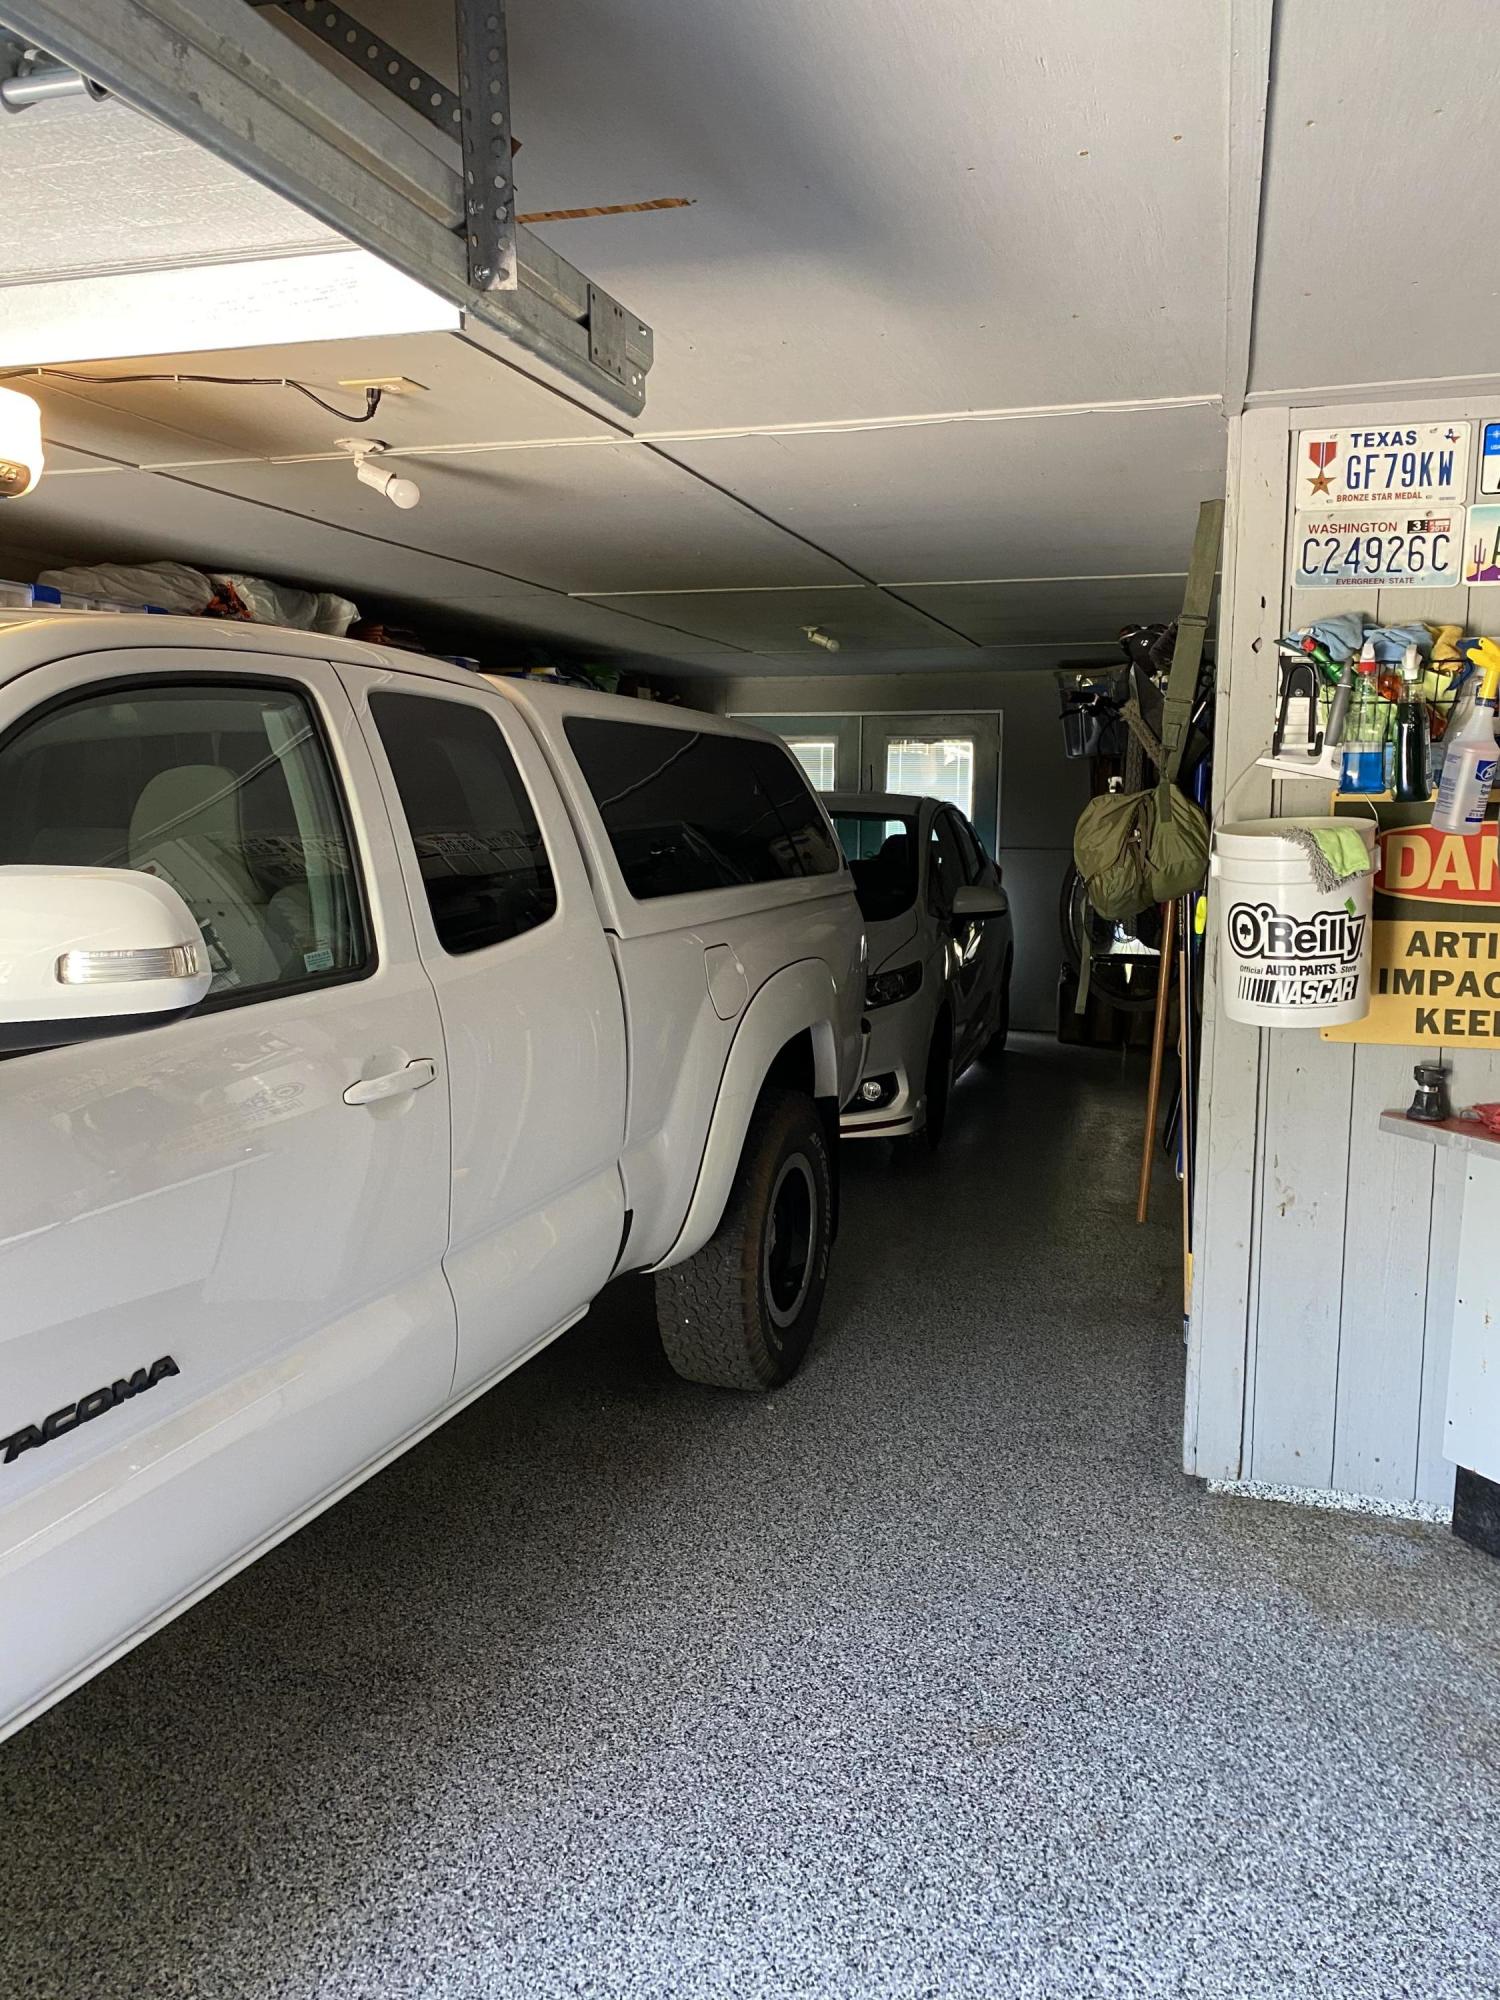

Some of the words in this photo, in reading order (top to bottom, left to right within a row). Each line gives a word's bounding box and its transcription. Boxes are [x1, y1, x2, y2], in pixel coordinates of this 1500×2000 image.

[1351, 430, 1417, 448] TEXAS
[1346, 450, 1454, 489] GF79KW
[1336, 494, 1369, 502] BRONZE
[1371, 492, 1393, 501] STAR
[1394, 491, 1422, 500] MEDAL
[1308, 521, 1398, 534] WASHINGTON
[1412, 520, 1421, 531] 3
[1302, 534, 1450, 574] C24926C
[1336, 577, 1385, 585] EVERGREEN
[1388, 576, 1415, 584] STATE
[1232, 909, 1361, 956] O'Reilly
[1405, 930, 1498, 959] ARTI
[1239, 964, 1263, 975] Official
[1265, 964, 1297, 976] AUTO
[1340, 964, 1357, 974] Store
[1379, 968, 1500, 999] IMPAC
[1271, 974, 1356, 1005] NASCAR
[0, 1355, 181, 1464] ACOMA
